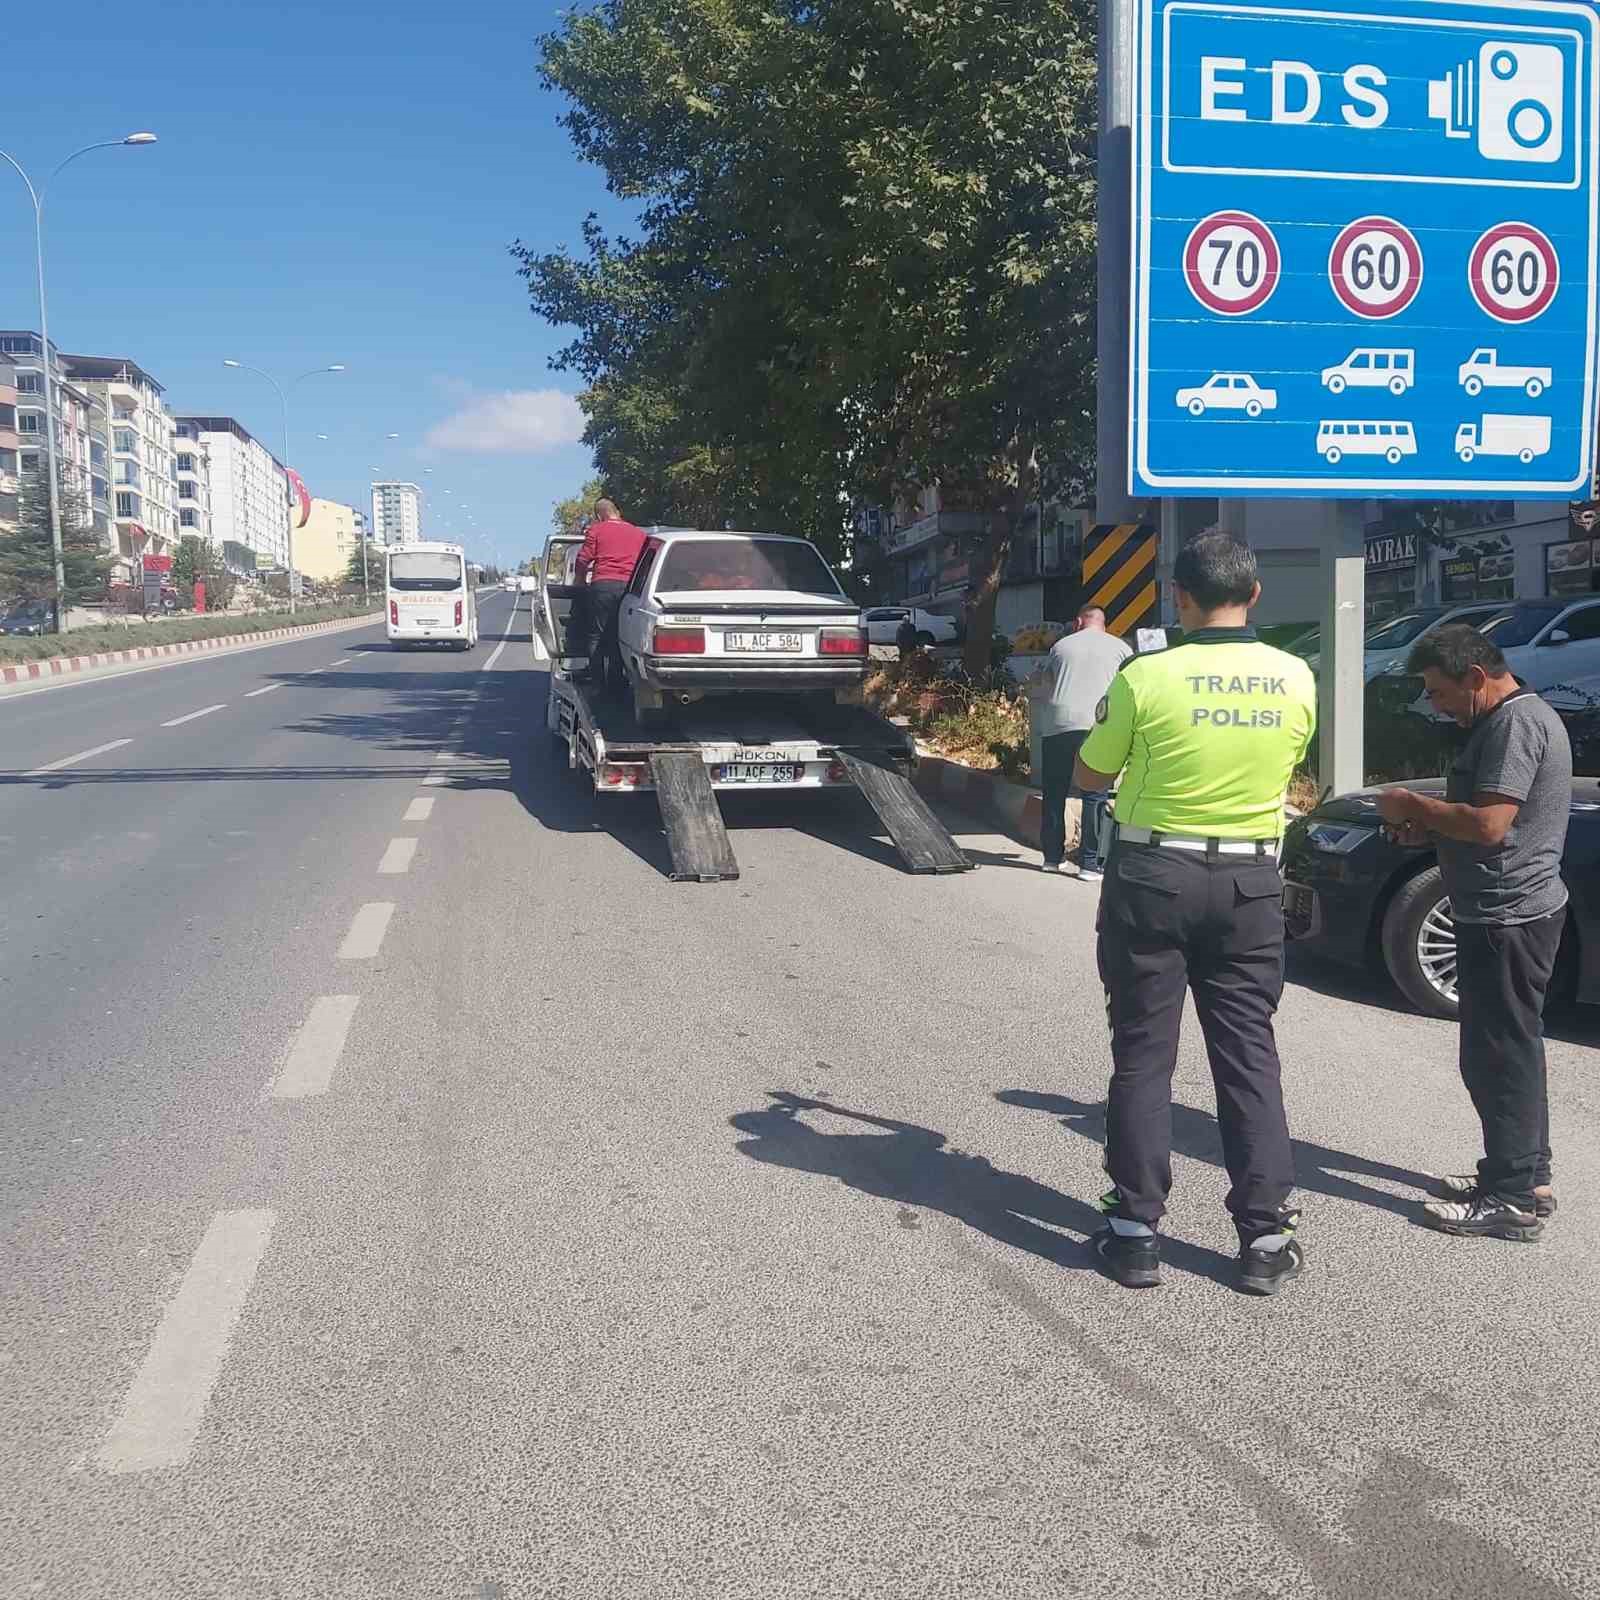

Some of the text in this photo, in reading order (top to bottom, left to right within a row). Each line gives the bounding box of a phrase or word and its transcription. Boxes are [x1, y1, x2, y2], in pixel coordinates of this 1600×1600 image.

[1207, 239, 1261, 289] 70
[1350, 243, 1401, 292] 60
[1491, 249, 1540, 298] 60
[732, 634, 800, 648] 11 ACF 584
[727, 765, 794, 780] 11 ACF 255
